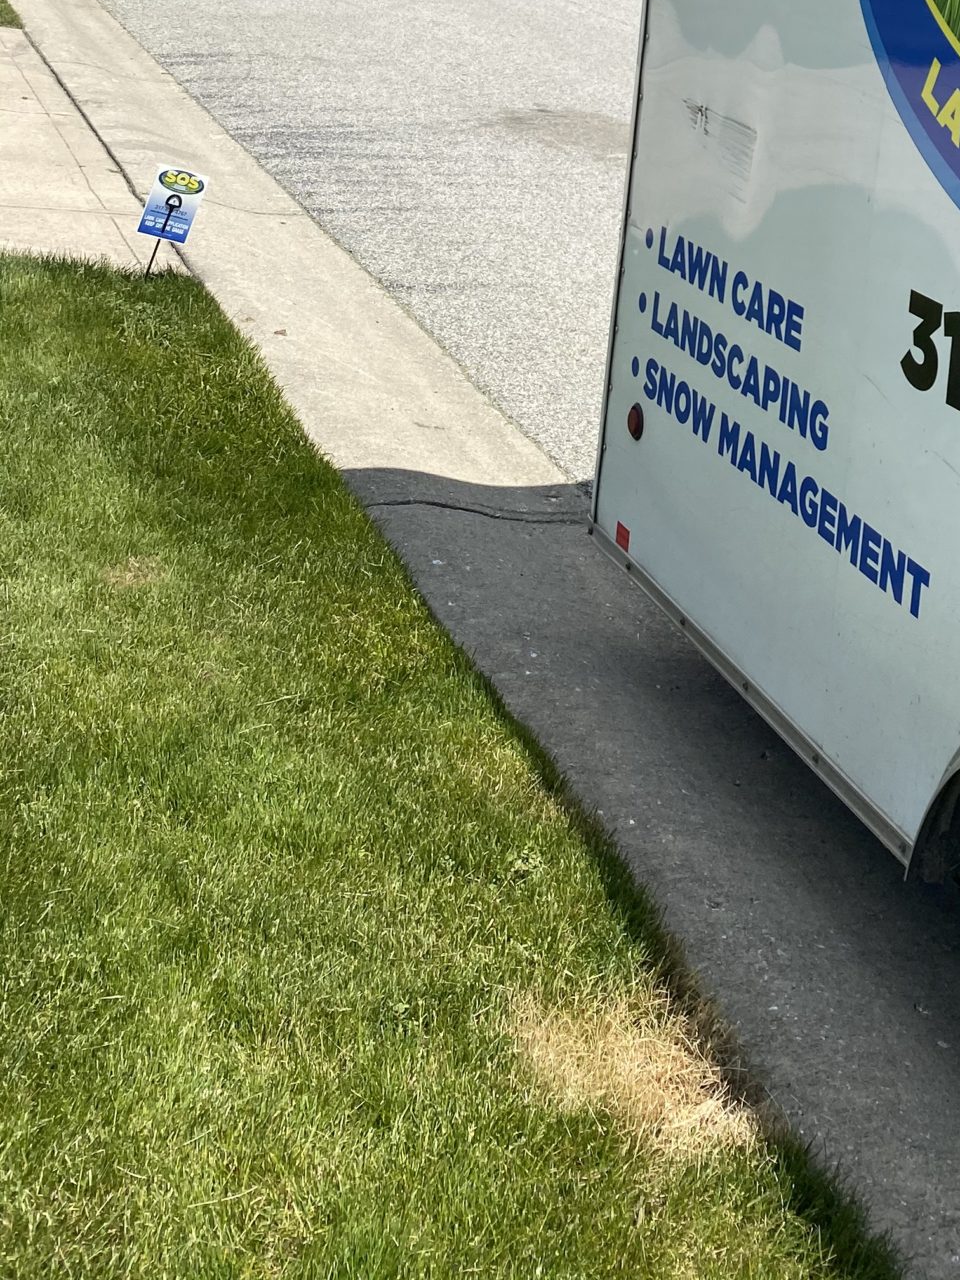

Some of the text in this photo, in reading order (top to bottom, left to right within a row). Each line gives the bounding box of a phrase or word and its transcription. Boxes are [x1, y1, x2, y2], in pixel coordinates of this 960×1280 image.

[165, 170, 200, 189] SOS
[657, 226, 805, 352] LAWN CARE
[650, 291, 830, 451] LANDSCAPING
[643, 358, 931, 620] SNOW MANAGEMENT
